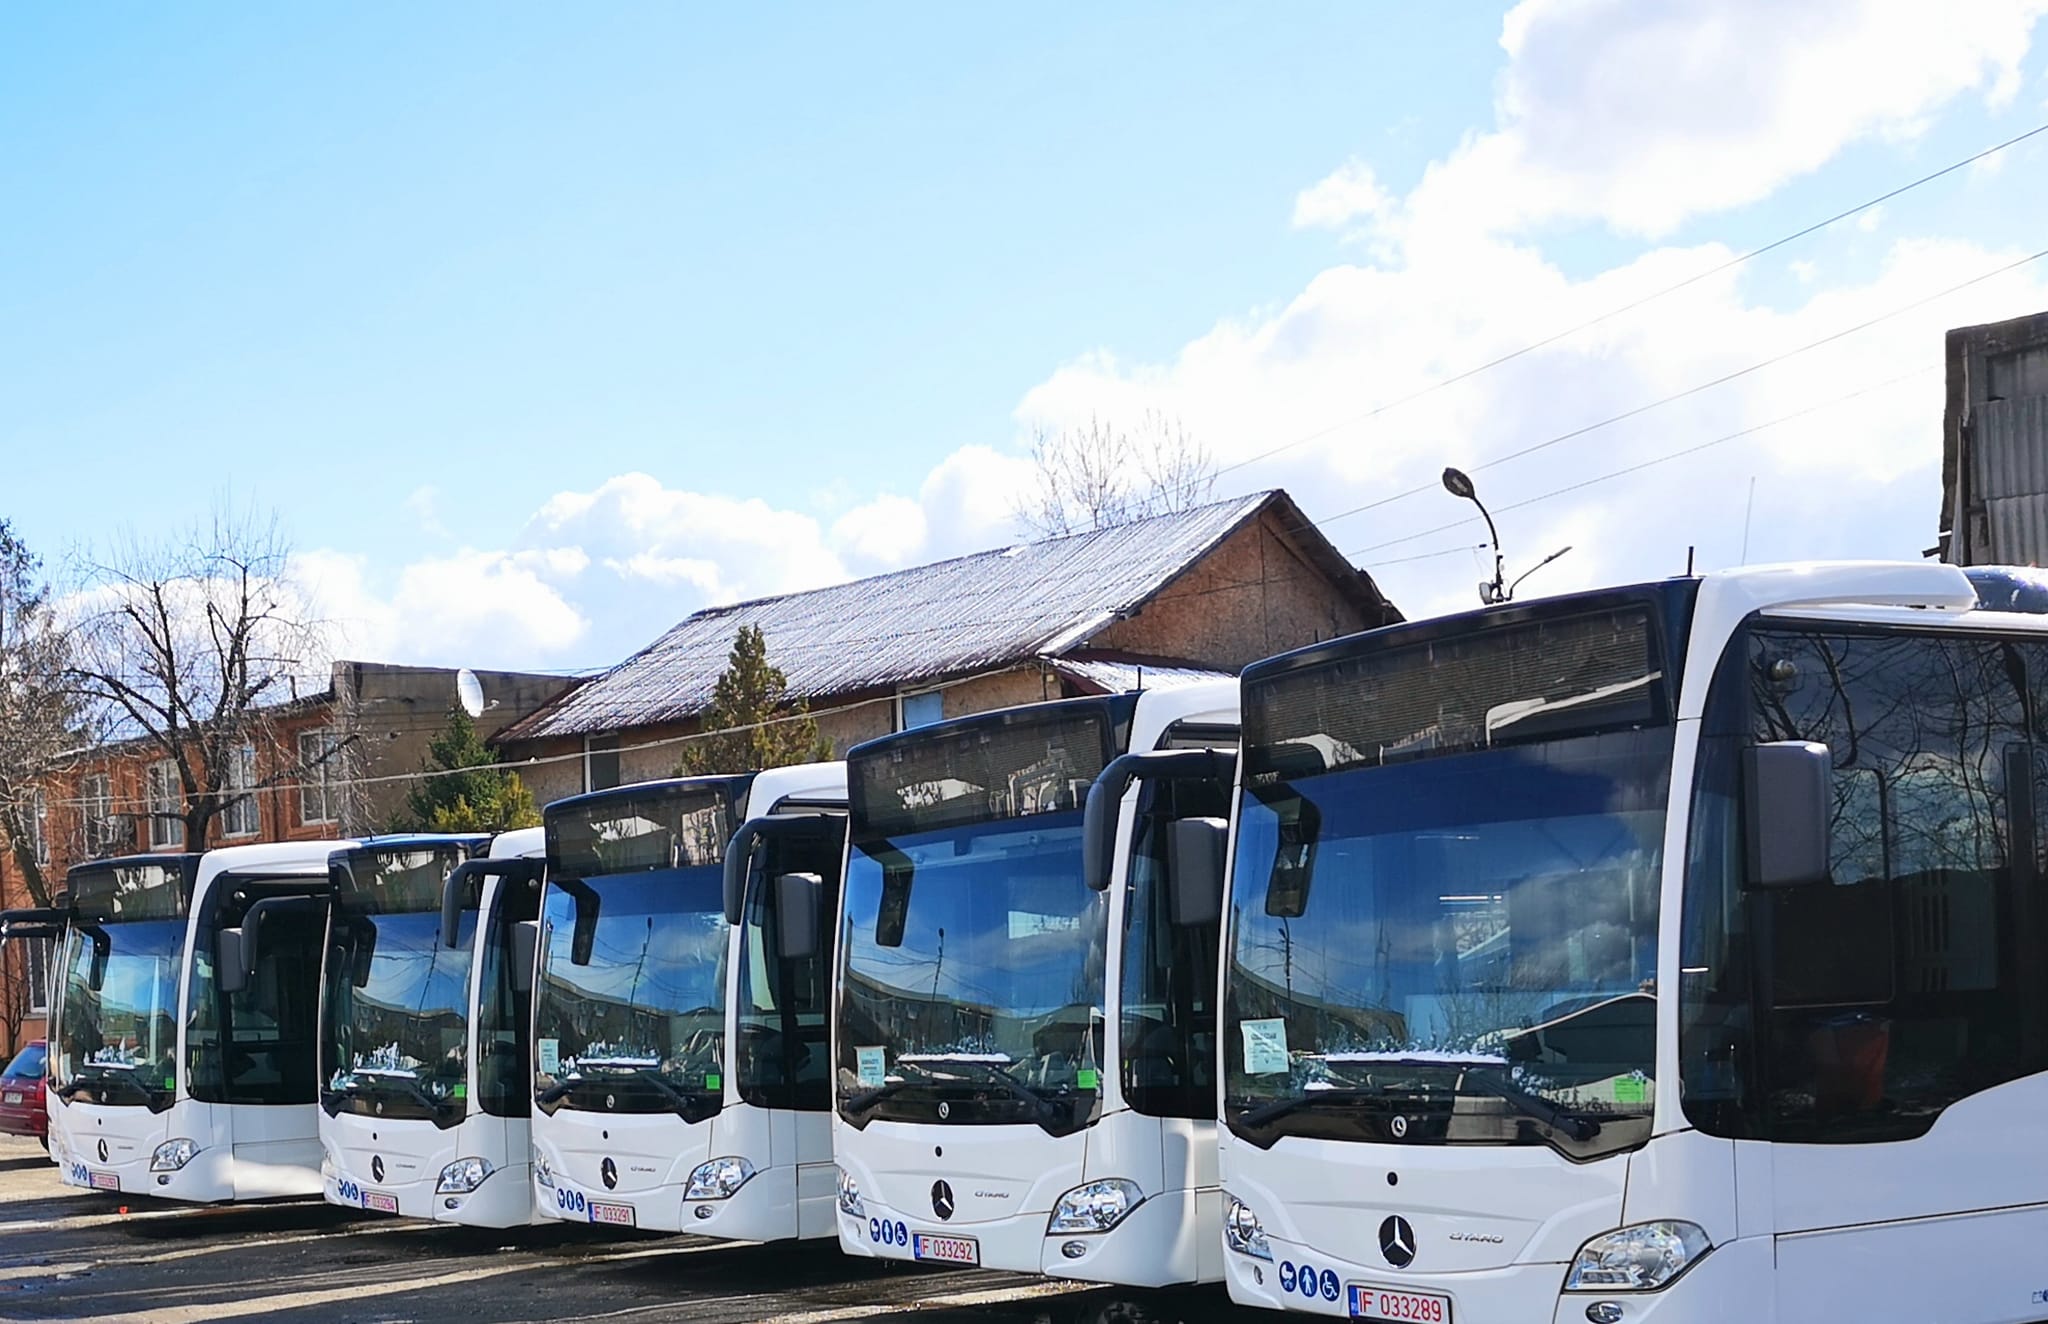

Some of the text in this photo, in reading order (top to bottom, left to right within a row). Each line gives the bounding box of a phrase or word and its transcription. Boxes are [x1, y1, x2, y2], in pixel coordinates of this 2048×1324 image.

[933, 1239, 973, 1260] 033292
[1359, 1290, 1442, 1322] IF 033289
